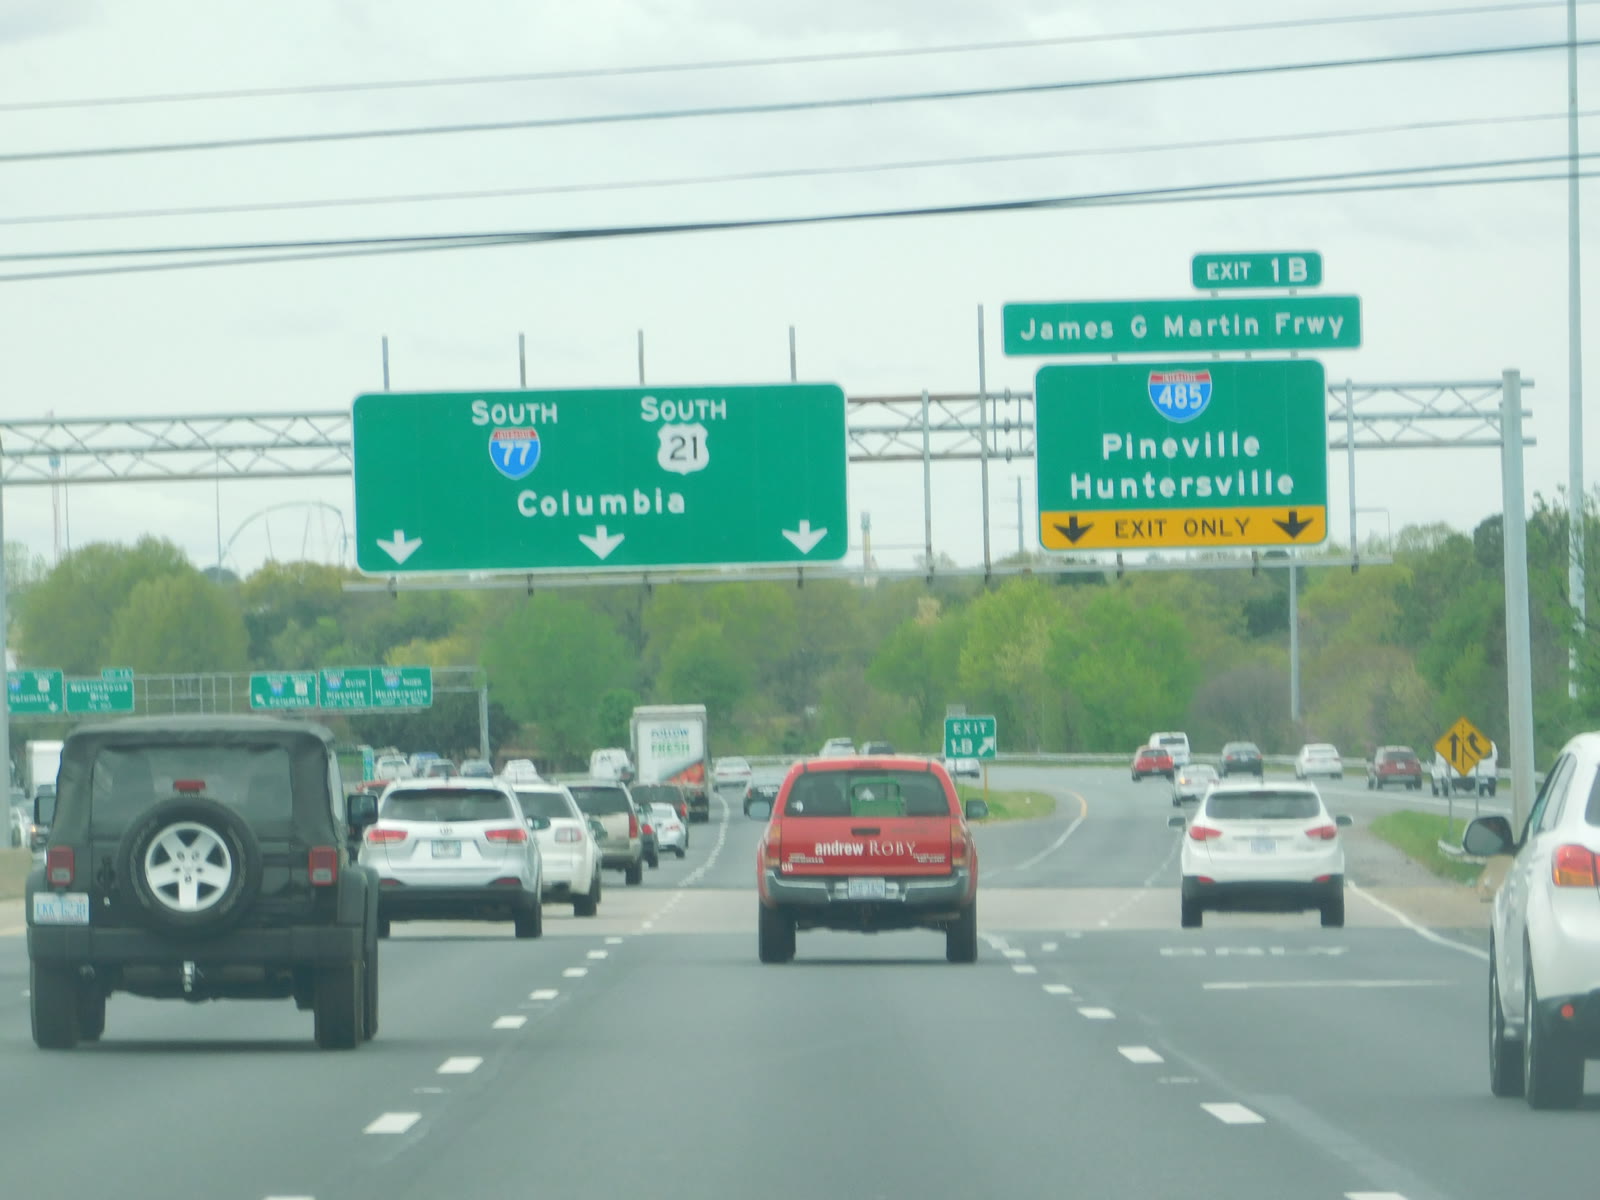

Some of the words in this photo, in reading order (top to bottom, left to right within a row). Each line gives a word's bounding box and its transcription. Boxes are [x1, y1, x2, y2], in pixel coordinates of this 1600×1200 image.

[1206, 261, 1251, 280] EXIT
[1020, 318, 1114, 341] James
[1130, 315, 1148, 338] G
[1164, 314, 1259, 337] Martin
[1275, 312, 1344, 339] Frwy
[640, 396, 727, 422] SOUTH
[1158, 384, 1203, 409] 485
[471, 400, 558, 426] SOUTH
[498, 440, 532, 466] 77
[669, 435, 699, 461] 21
[1102, 431, 1260, 460] Pineville
[1070, 469, 1294, 499] Huntersville
[517, 489, 685, 517] Columbia
[1114, 519, 1167, 539] EXIT
[1183, 517, 1250, 537] ONLY
[953, 721, 987, 735] EXIT
[815, 840, 864, 856] andrew
[869, 840, 916, 856] ROBY
